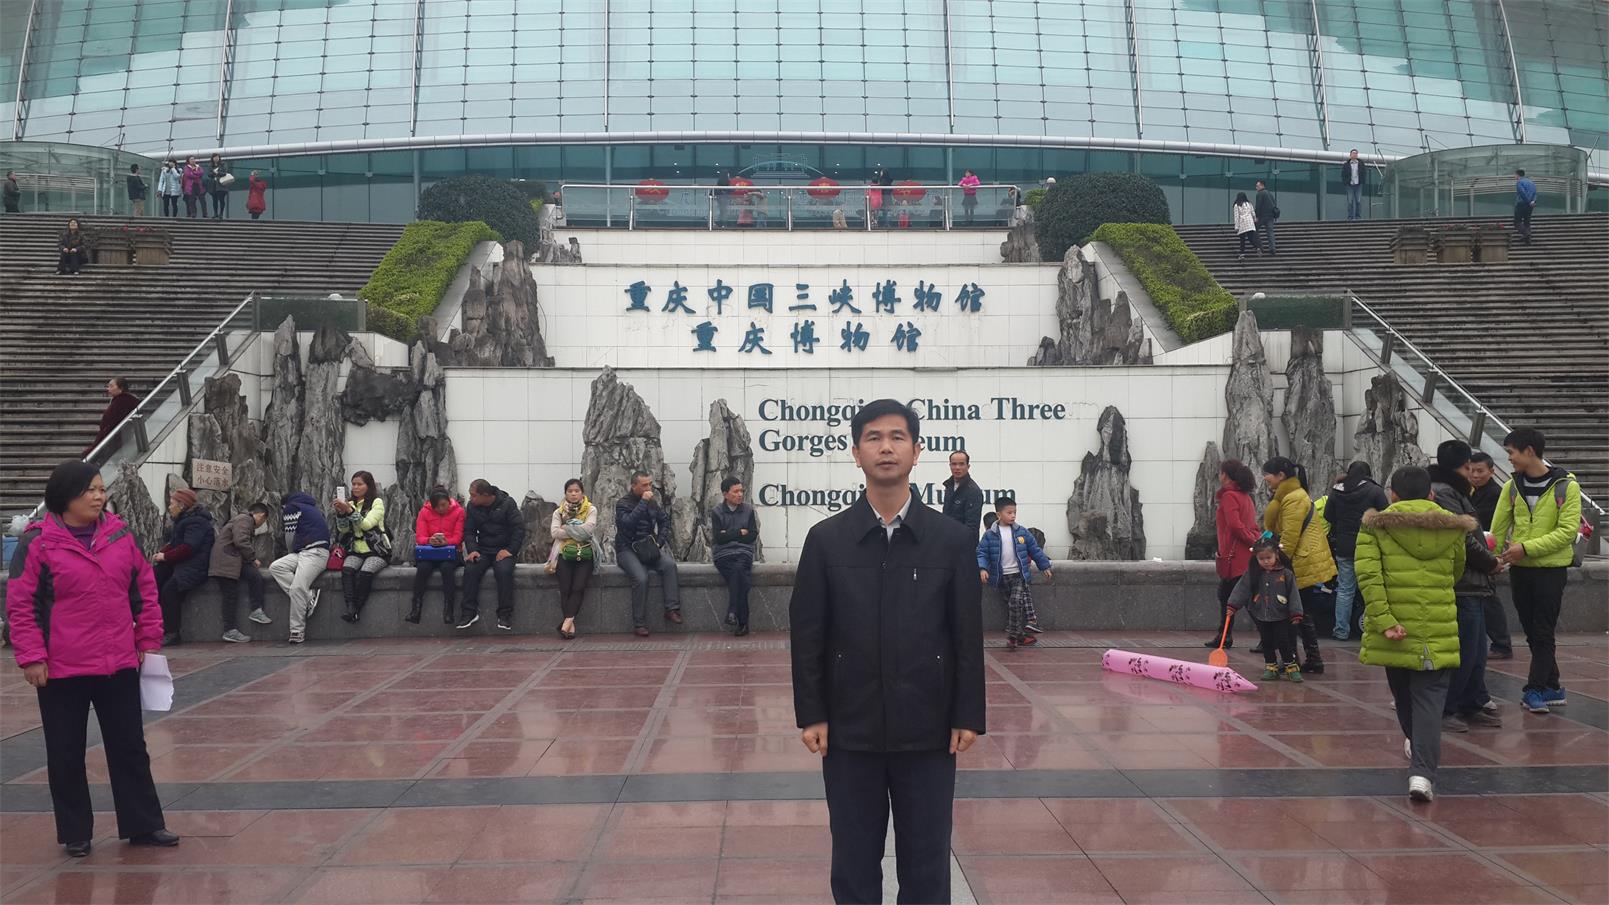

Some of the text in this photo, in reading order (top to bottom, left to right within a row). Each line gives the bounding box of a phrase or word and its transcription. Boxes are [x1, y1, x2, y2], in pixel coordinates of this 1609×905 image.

[691, 320, 922, 355] 重庆博物馆
[758, 397, 1066, 427] Chongq China Three
[758, 429, 848, 457] Gorges
[196, 462, 230, 475] 注意安全
[758, 482, 1016, 512] Chongq Muum
